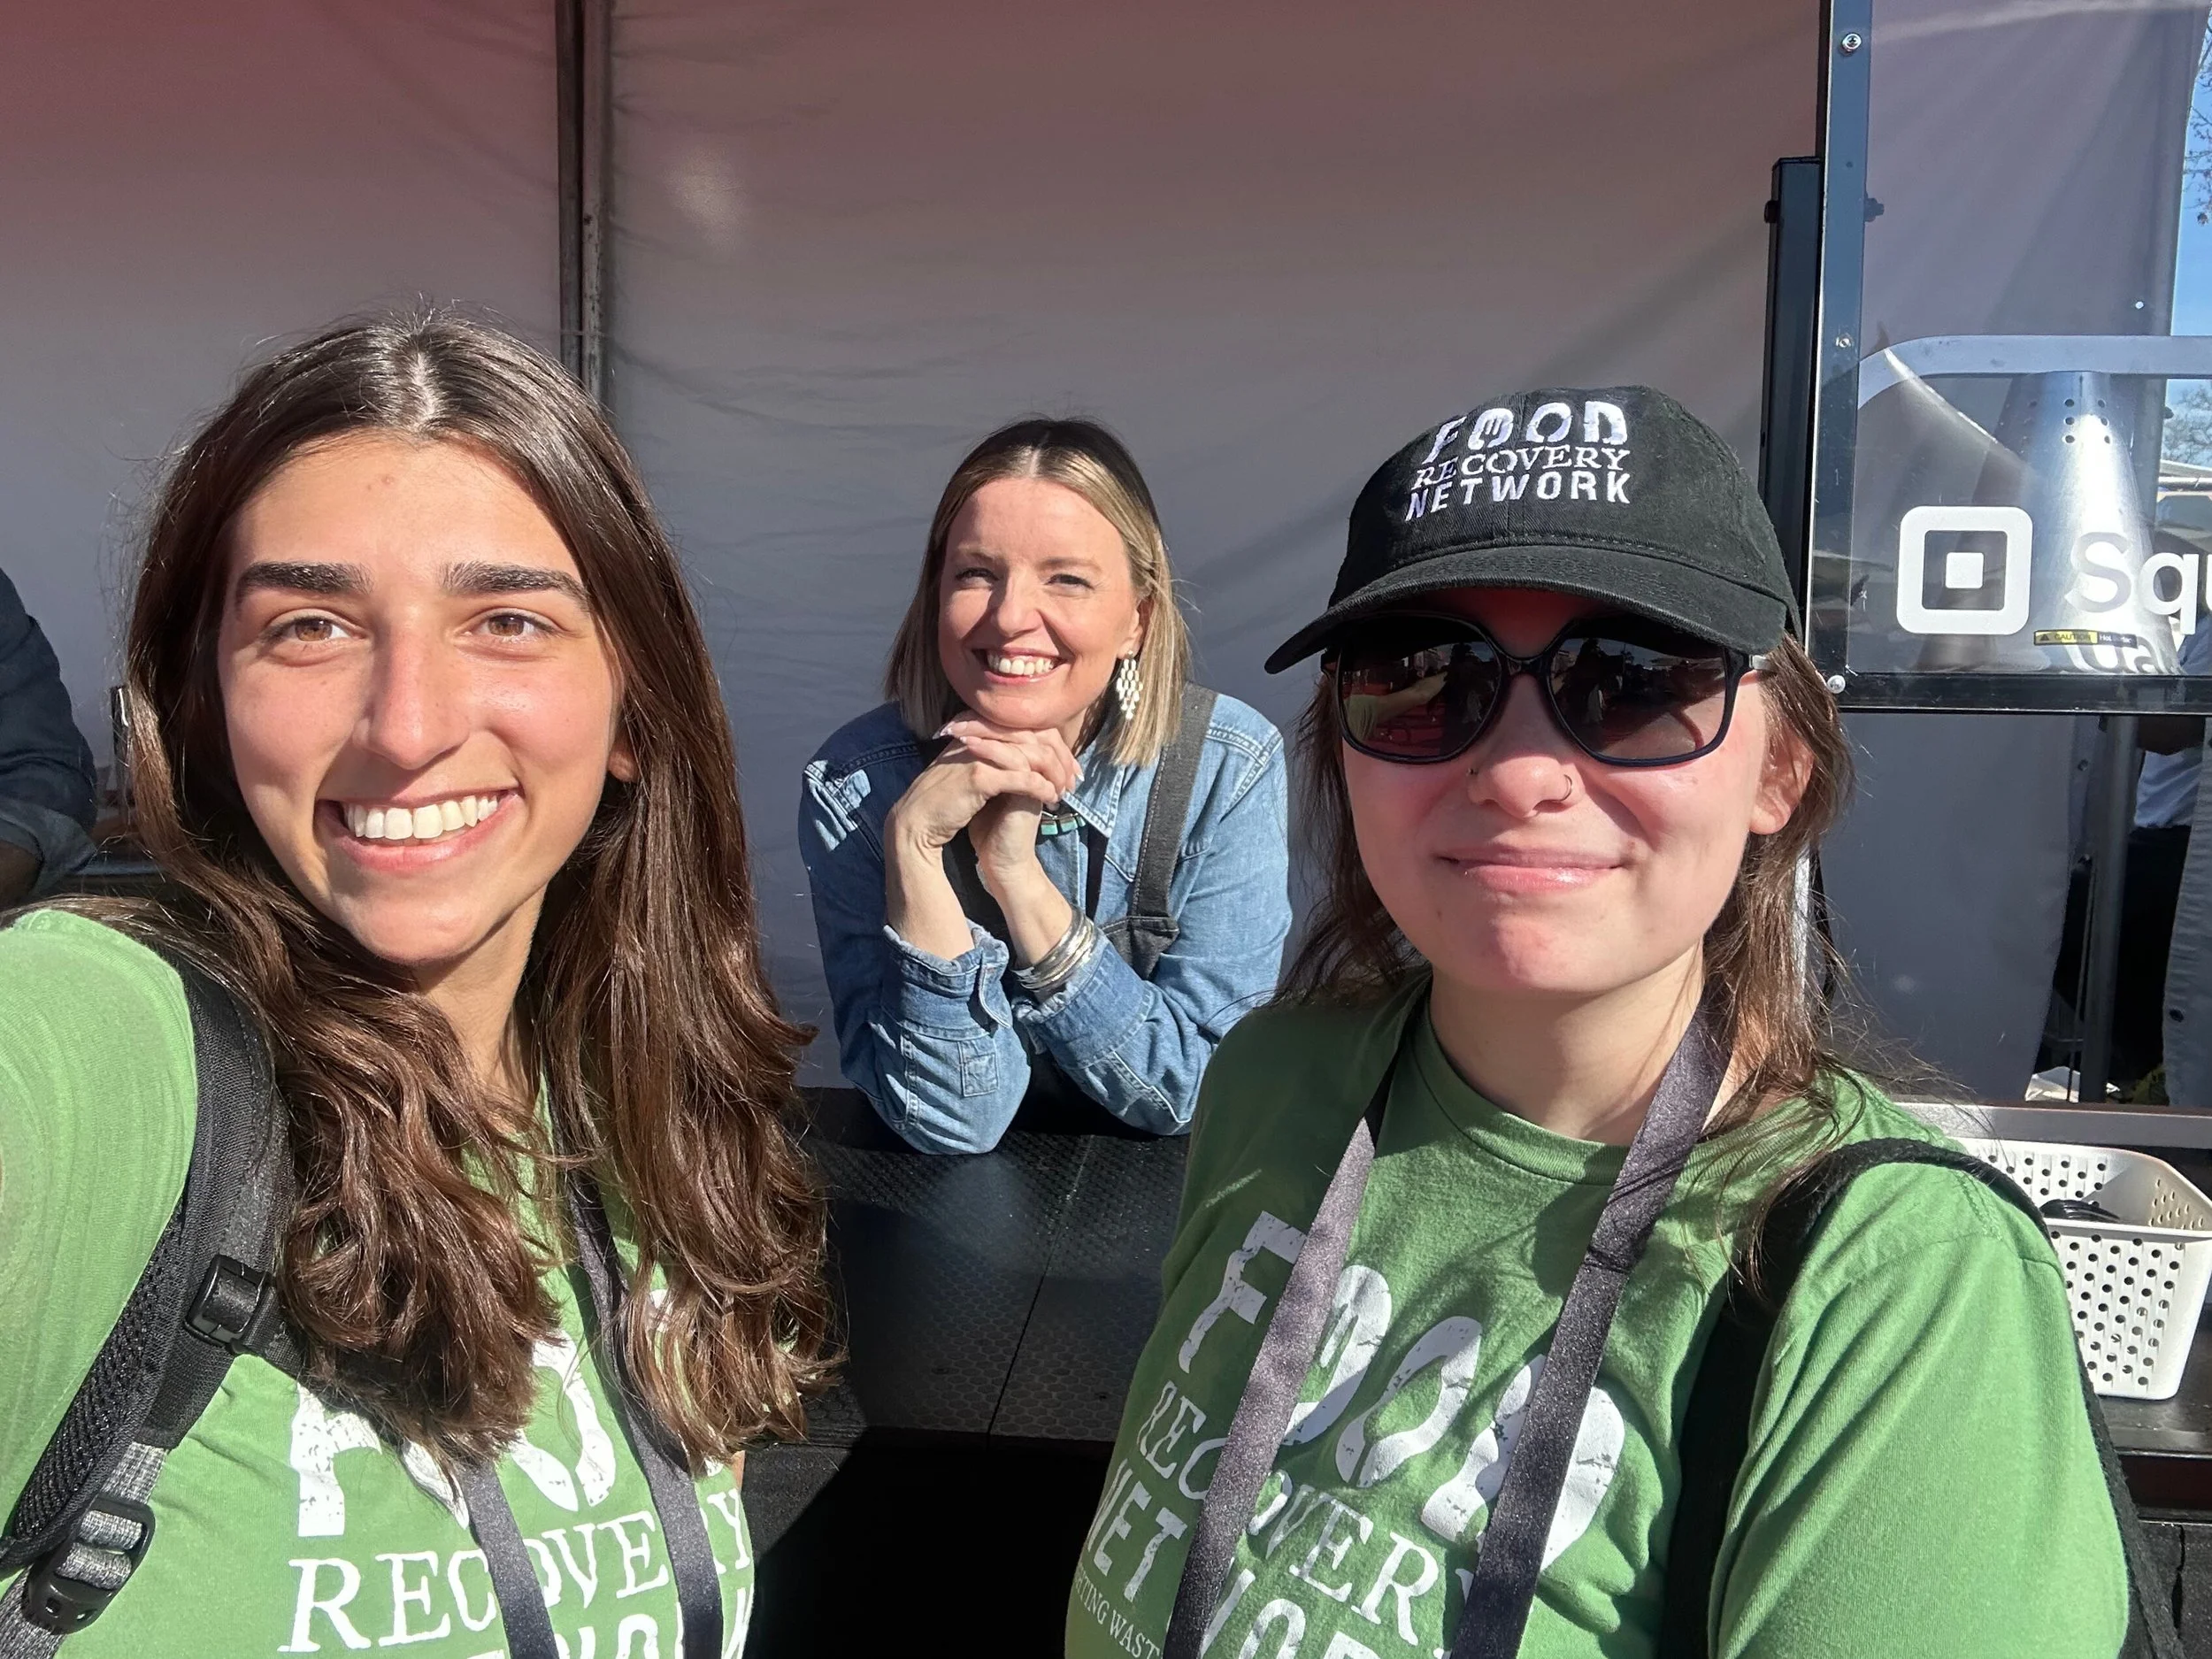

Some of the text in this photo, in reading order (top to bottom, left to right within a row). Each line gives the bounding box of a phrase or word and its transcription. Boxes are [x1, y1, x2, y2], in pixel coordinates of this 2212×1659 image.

[1422, 400, 1628, 465] FOOD
[1410, 444, 1631, 491] RECOVERY
[1404, 470, 1631, 522] NETWORK
[2064, 531, 2212, 635] Sq
[2054, 633, 2091, 642] CAUTION
[276, 1487, 751, 1654] RECOVEY
[1110, 1609, 1164, 1659] WAST
